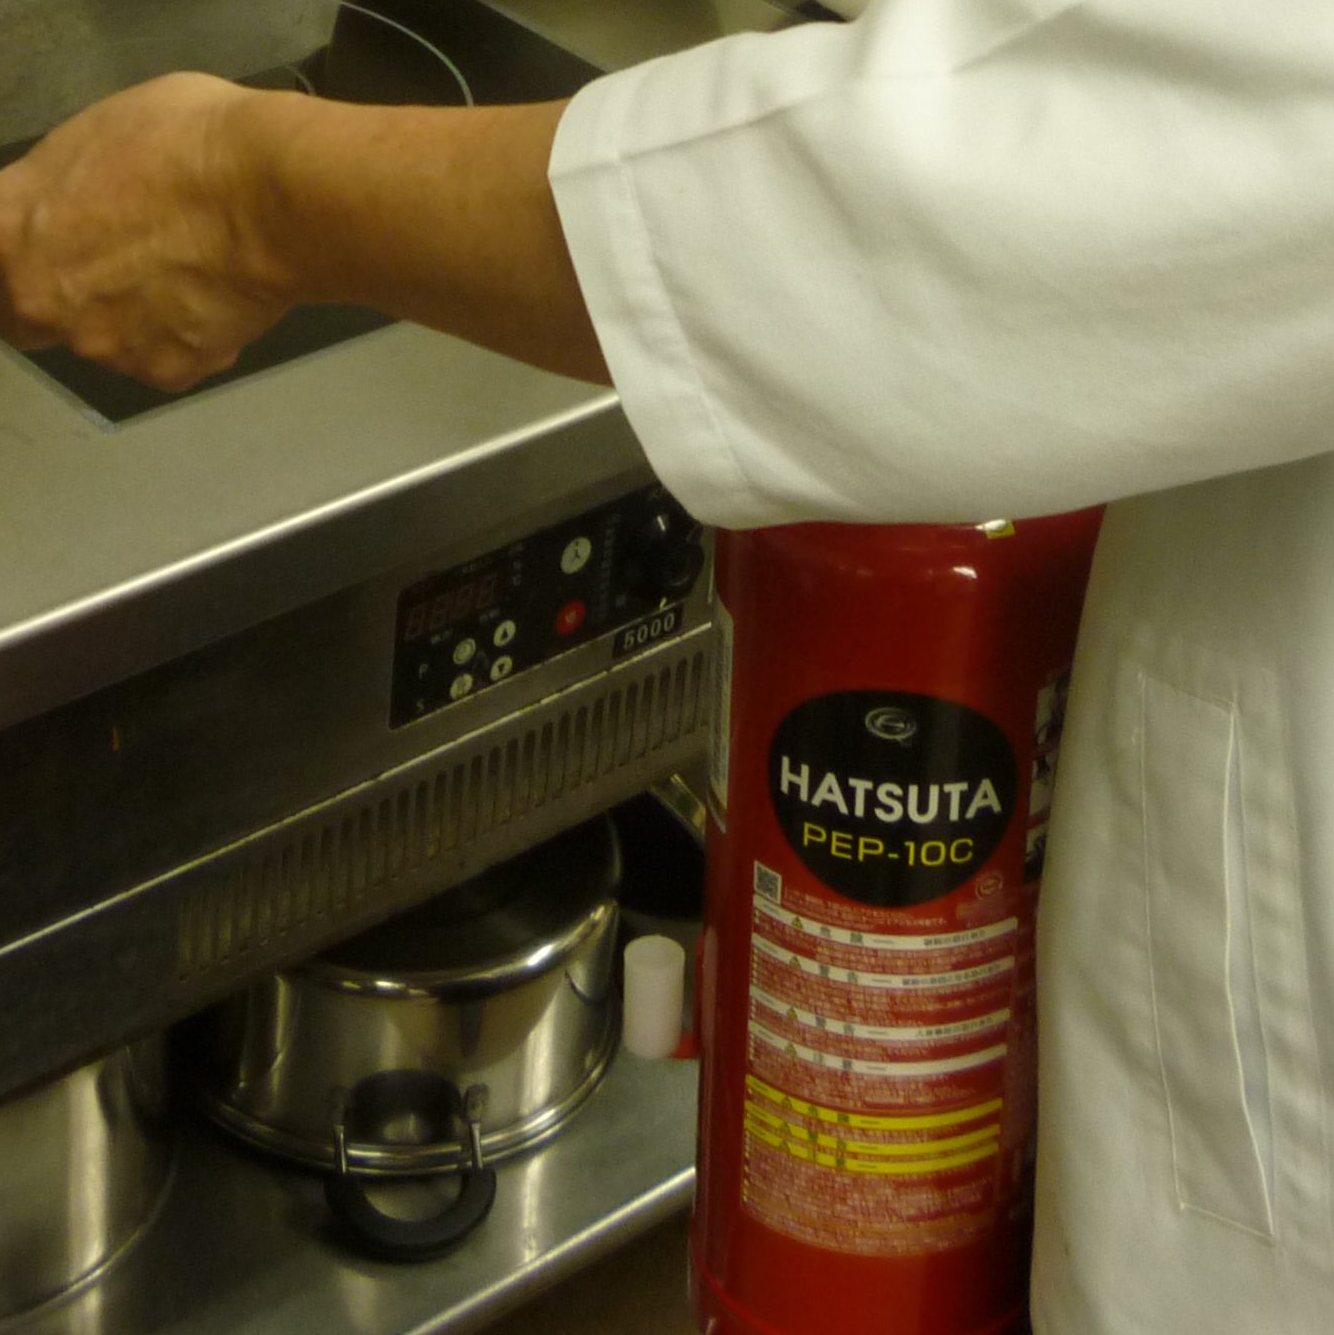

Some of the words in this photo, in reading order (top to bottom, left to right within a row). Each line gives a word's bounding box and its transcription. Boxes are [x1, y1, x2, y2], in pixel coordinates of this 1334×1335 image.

[622, 613, 676, 651] 5000
[780, 755, 1002, 825] HATSUTA
[802, 822, 974, 867] PEP-10C
